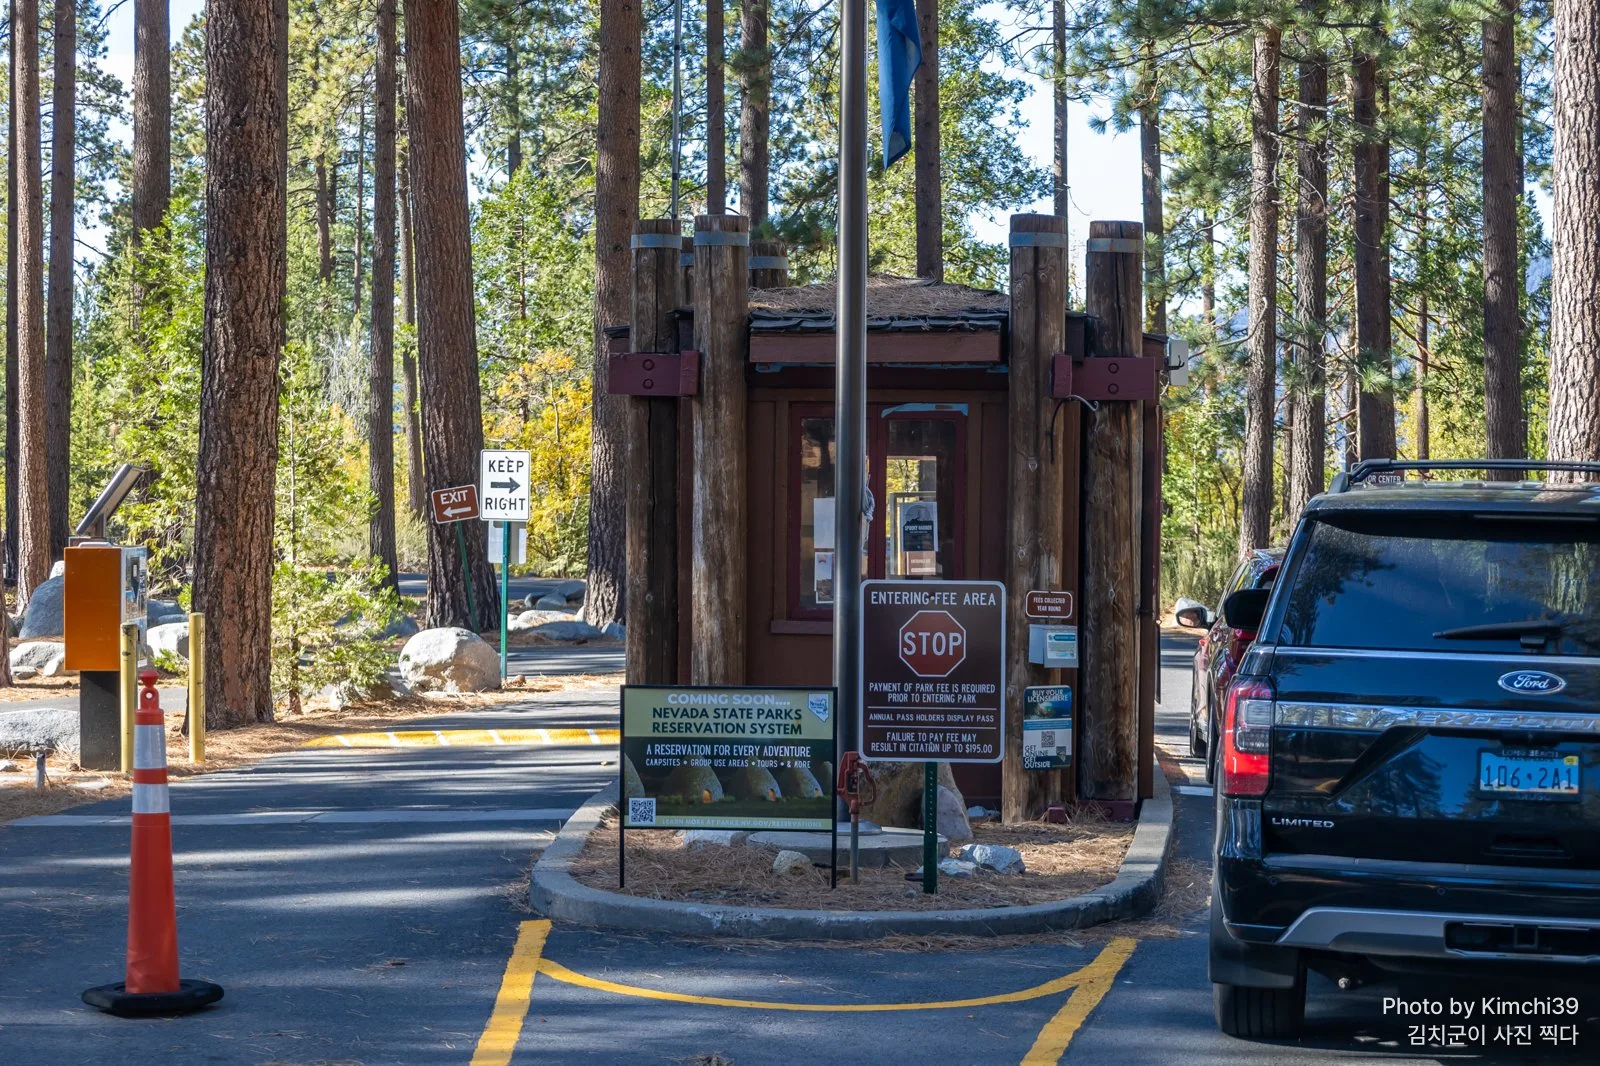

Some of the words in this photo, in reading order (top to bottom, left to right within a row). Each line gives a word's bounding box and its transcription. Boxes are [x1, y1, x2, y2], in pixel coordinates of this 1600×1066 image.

[488, 460, 525, 473] KEEP
[1378, 475, 1401, 484] CENTER
[440, 489, 468, 505] EXIT
[485, 498, 526, 511] RIGHT
[871, 591, 930, 605] ENTERING
[934, 592, 957, 605] FEE
[963, 592, 996, 606] AREA
[903, 631, 962, 656] STOP
[1514, 674, 1550, 689] Ford
[869, 683, 900, 692] PAYMENT
[904, 683, 912, 692] OF
[916, 683, 934, 693] PARK
[937, 683, 950, 693] FEE
[952, 684, 959, 693] IS
[962, 684, 995, 693] REQUIRED
[1032, 689, 1045, 697] BUY
[668, 693, 729, 705] COMING
[888, 693, 908, 702] PRIOR
[911, 693, 920, 703] TO
[922, 694, 955, 703] ENTERING
[958, 694, 976, 704] PARK
[652, 707, 709, 719] NEVADA
[713, 707, 753, 719] STATE
[757, 708, 802, 720] PARKS
[869, 713, 894, 721] ANNUAL
[896, 713, 914, 721] PASS
[916, 714, 945, 722] HOLDERS
[947, 714, 974, 722] DISPLAY
[652, 721, 746, 734] RESERVATION
[749, 723, 802, 735] SYSTEM
[886, 732, 915, 742] FAILURE
[918, 732, 926, 742] TO
[929, 733, 944, 742] PAY
[946, 733, 959, 742] FEE
[962, 733, 977, 743] MAY
[646, 744, 652, 755] A
[654, 744, 711, 755] RESERVATION
[713, 744, 730, 756] FOR
[733, 745, 760, 756] EVERY
[763, 745, 811, 757] ADVENTURE
[871, 742, 897, 752] RESULT
[900, 743, 907, 752] IN
[908, 743, 940, 753] CITATION
[942, 743, 951, 753] UP
[954, 744, 963, 753] TO
[965, 744, 993, 753] $195.00
[645, 758, 681, 767] CAMPSITES
[690, 758, 712, 767] GROUP
[714, 759, 726, 767] USE
[728, 759, 749, 767] AREAS
[757, 759, 778, 768] TOURS
[786, 760, 791, 768] &
[794, 760, 811, 768] MORE
[1024, 761, 1051, 769] OUTSIDE
[1271, 817, 1335, 828] LIMITED
